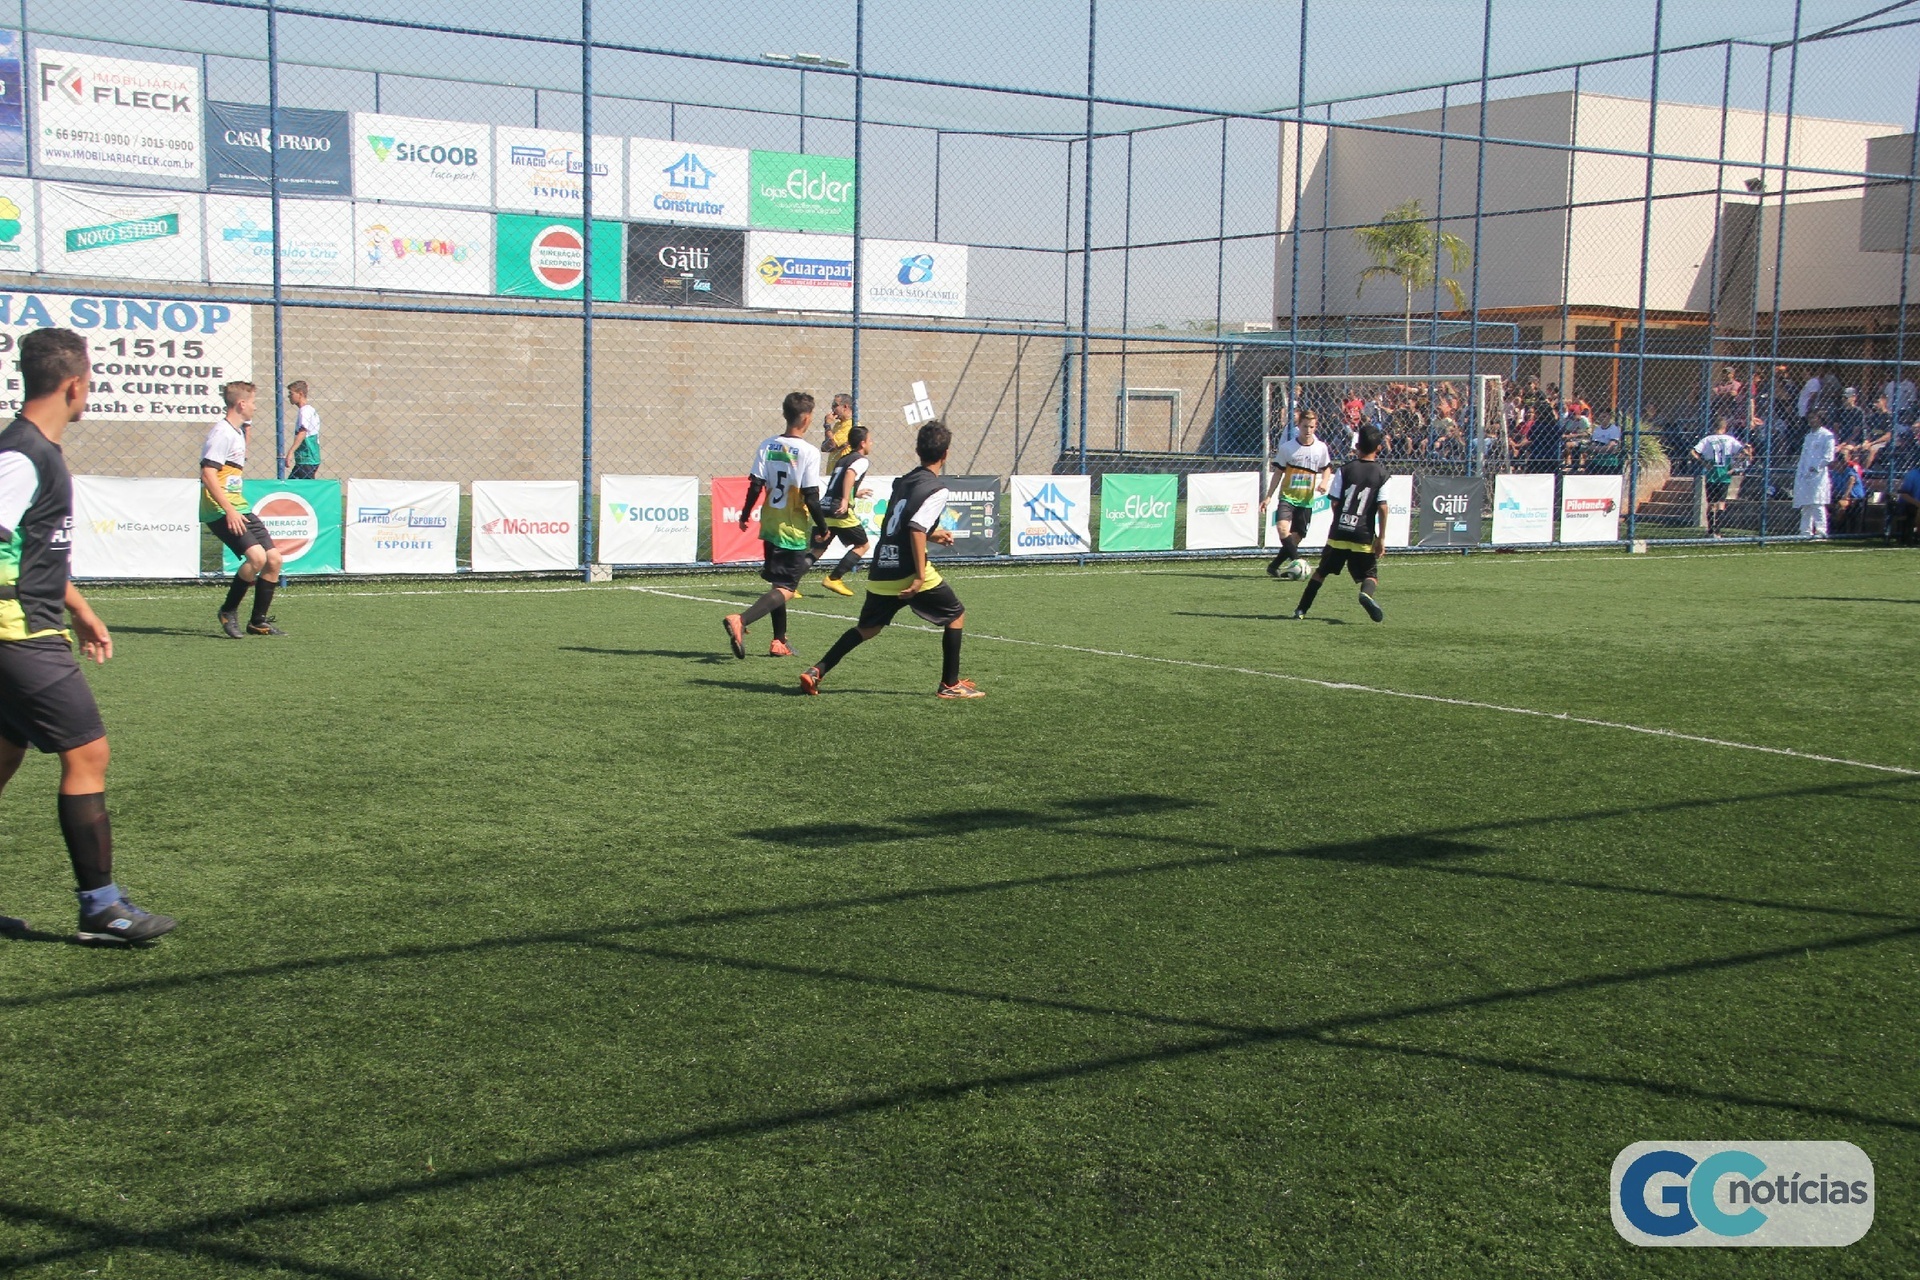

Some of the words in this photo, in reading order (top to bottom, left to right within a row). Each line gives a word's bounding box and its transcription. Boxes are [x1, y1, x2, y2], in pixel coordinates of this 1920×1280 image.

[94, 86, 191, 113] FLECK
[56, 128, 69, 140] 66
[141, 137, 195, 151] 3015-0900
[225, 131, 262, 148] CASA
[279, 134, 331, 152] PRADO
[397, 142, 478, 166] SICOOB
[533, 186, 597, 201] ESPORE
[761, 183, 787, 200] Lojas
[786, 168, 852, 203] Elder
[654, 193, 725, 216] Construtor
[77, 228, 116, 249] NOVO
[118, 219, 168, 241] ESTADO
[252, 244, 306, 260] Osaldo
[310, 246, 338, 260] Cruz
[658, 246, 711, 271] Gatti
[540, 259, 582, 268] AEROPORTO
[783, 259, 852, 280] Guarapari
[70, 298, 231, 334] SINOP
[93, 363, 224, 379] CONVOQUE
[123, 382, 208, 396] CURTIR
[133, 404, 144, 413] e
[773, 471, 787, 504] 5
[1105, 508, 1126, 522] Lojas
[1124, 495, 1172, 519] Elder
[1343, 484, 1371, 516] 11
[1432, 494, 1469, 515] Gatti
[1567, 499, 1606, 511] Pilotando
[629, 506, 690, 522] SICOOB
[886, 498, 907, 536] 8
[117, 522, 192, 534] MEGAMODAS
[503, 518, 571, 536] Mônaco
[377, 540, 433, 549] ESPORTE
[1018, 531, 1082, 547] Construtor
